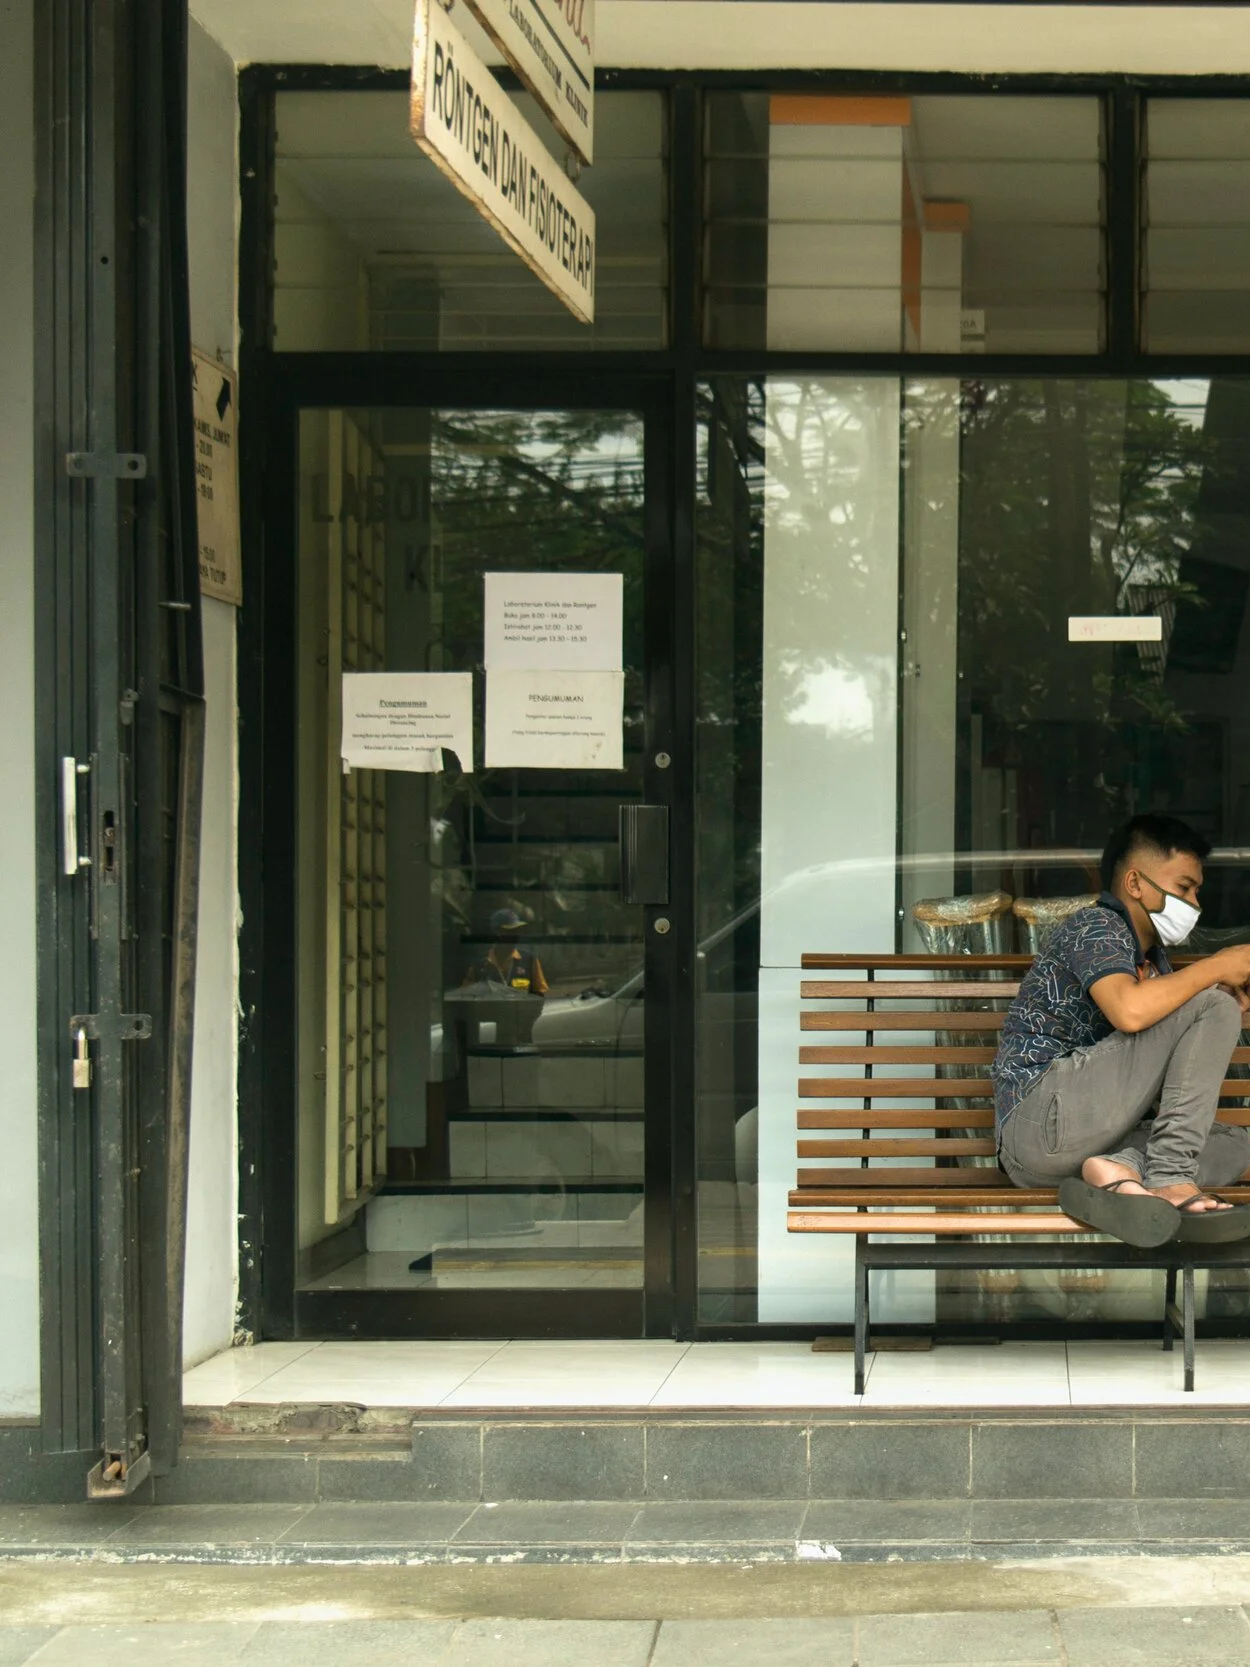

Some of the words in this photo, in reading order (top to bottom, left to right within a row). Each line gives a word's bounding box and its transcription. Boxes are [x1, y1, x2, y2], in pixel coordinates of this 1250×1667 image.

[503, 130, 527, 220] DAN
[528, 694, 584, 702] PENGUMUMAN
[380, 699, 427, 708] Pengumuman
